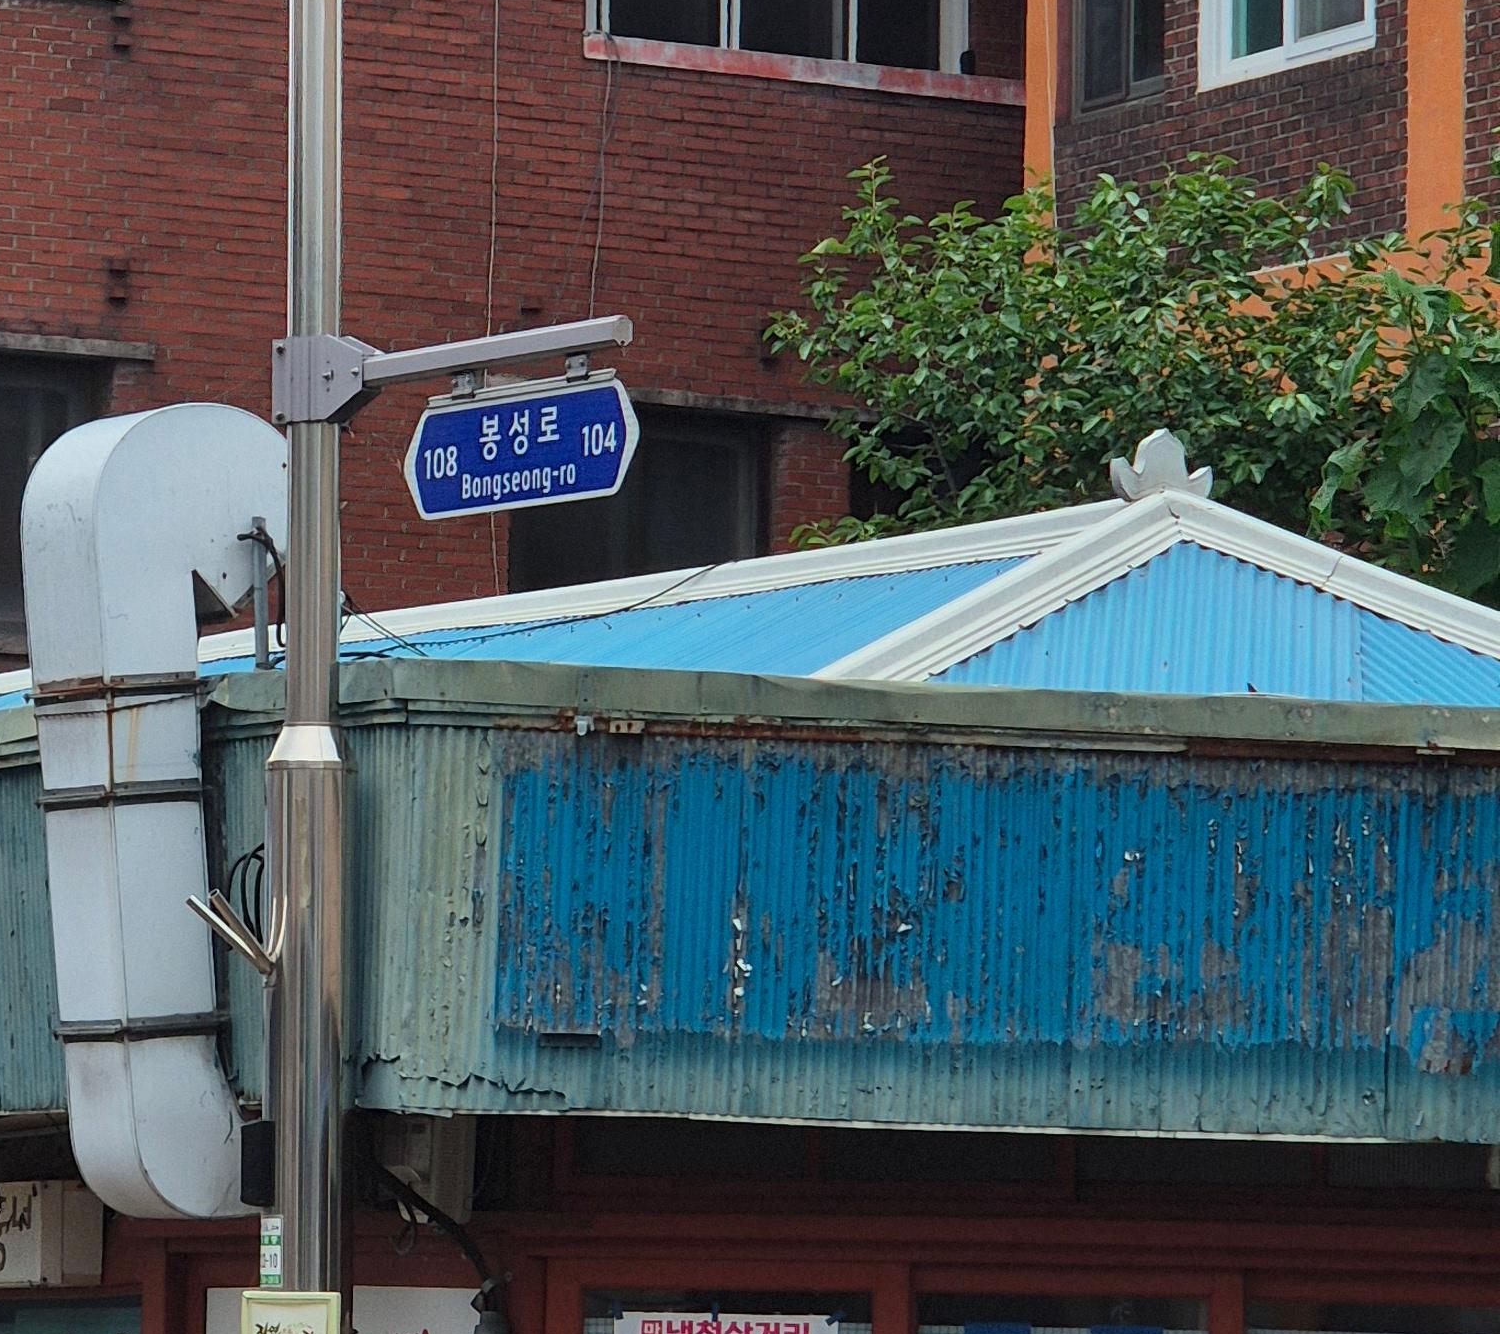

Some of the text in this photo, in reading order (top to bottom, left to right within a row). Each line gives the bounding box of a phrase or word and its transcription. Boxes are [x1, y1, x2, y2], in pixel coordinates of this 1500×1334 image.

[423, 405, 617, 480] 108 봉성로 104
[461, 463, 576, 501] Bongseong-ro
